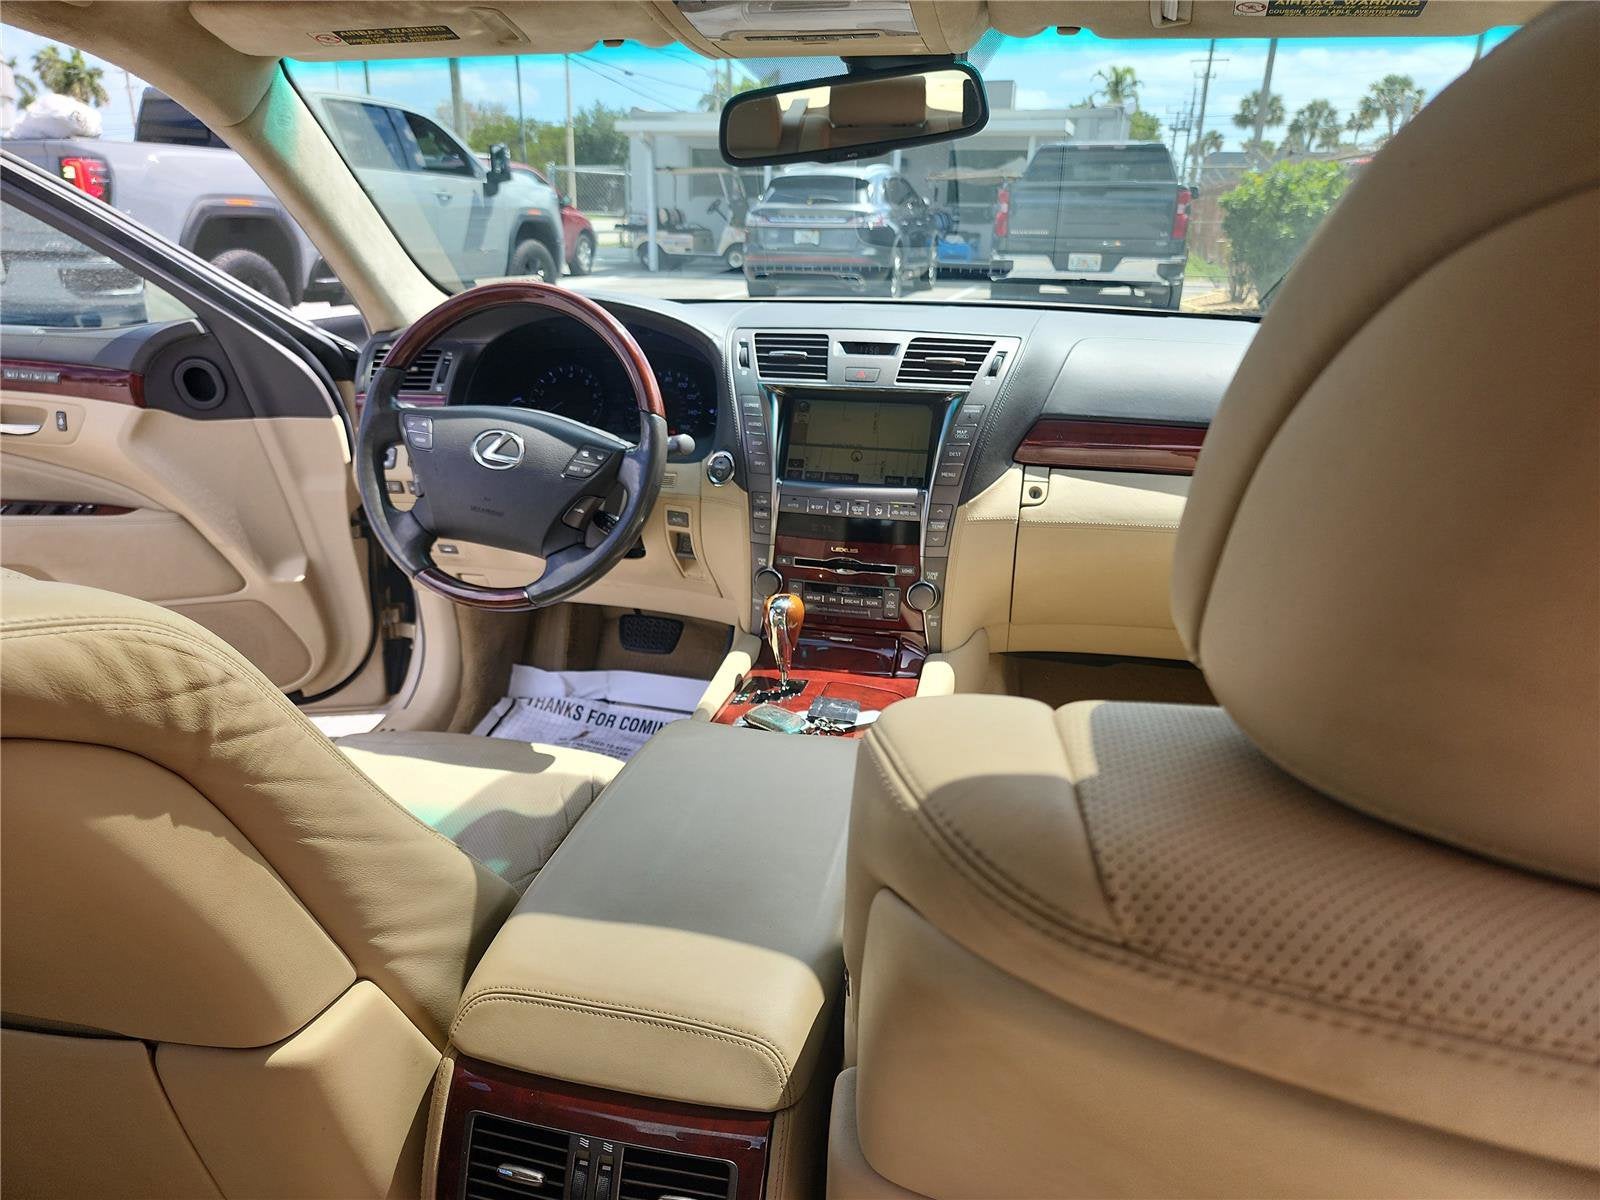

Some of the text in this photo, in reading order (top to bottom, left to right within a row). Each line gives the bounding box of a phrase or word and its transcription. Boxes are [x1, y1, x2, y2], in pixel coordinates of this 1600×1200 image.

[527, 697, 667, 735] THANKS FOR COMIN
